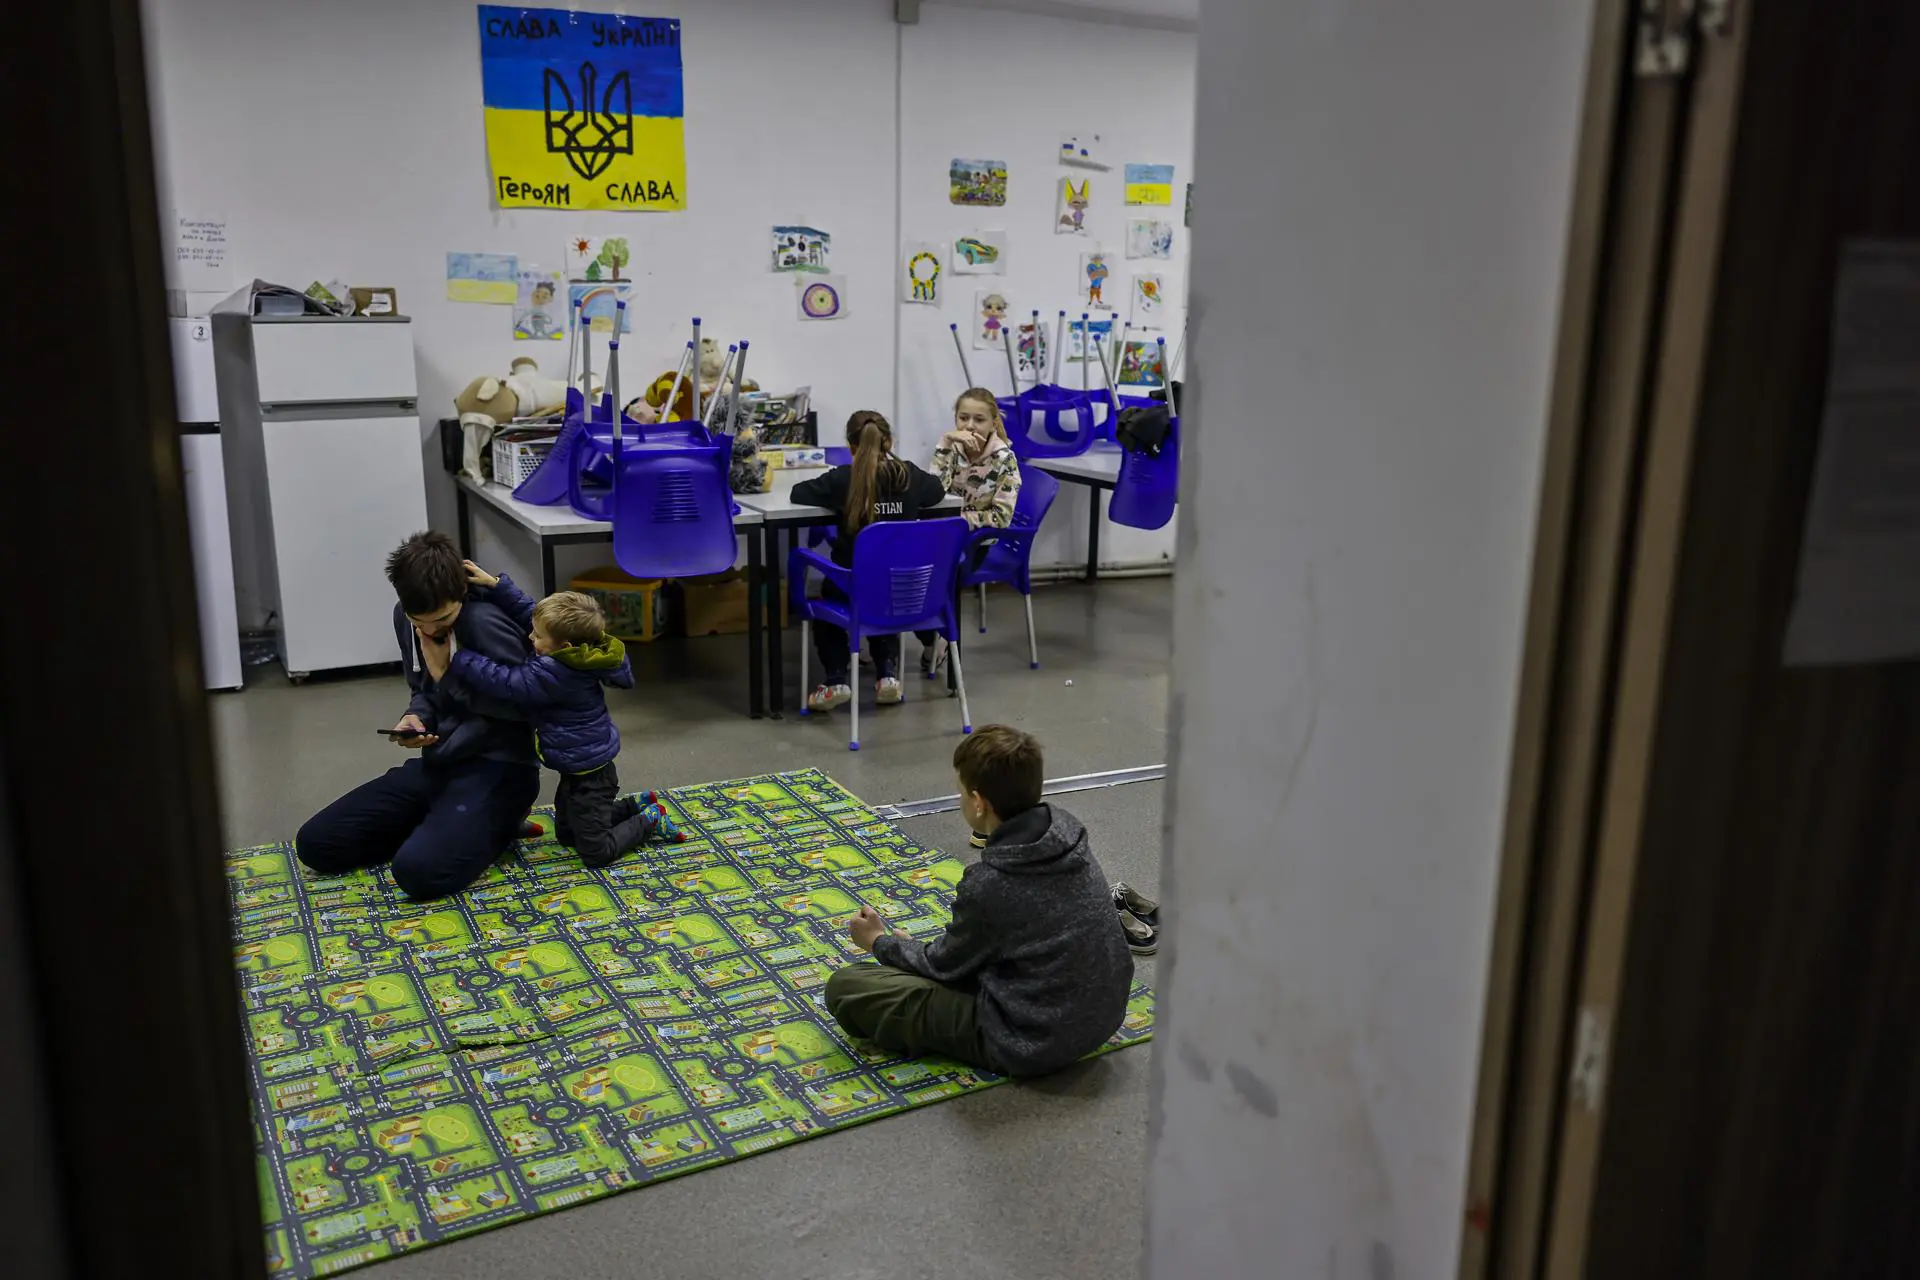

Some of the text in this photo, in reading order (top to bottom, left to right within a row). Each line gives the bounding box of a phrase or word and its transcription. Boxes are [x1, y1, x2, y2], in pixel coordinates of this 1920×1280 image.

[486, 18, 562, 40] СЛАВА
[605, 180, 675, 203] СЛАВА
[198, 325, 204, 337] 3
[873, 501, 903, 515] STIAN
